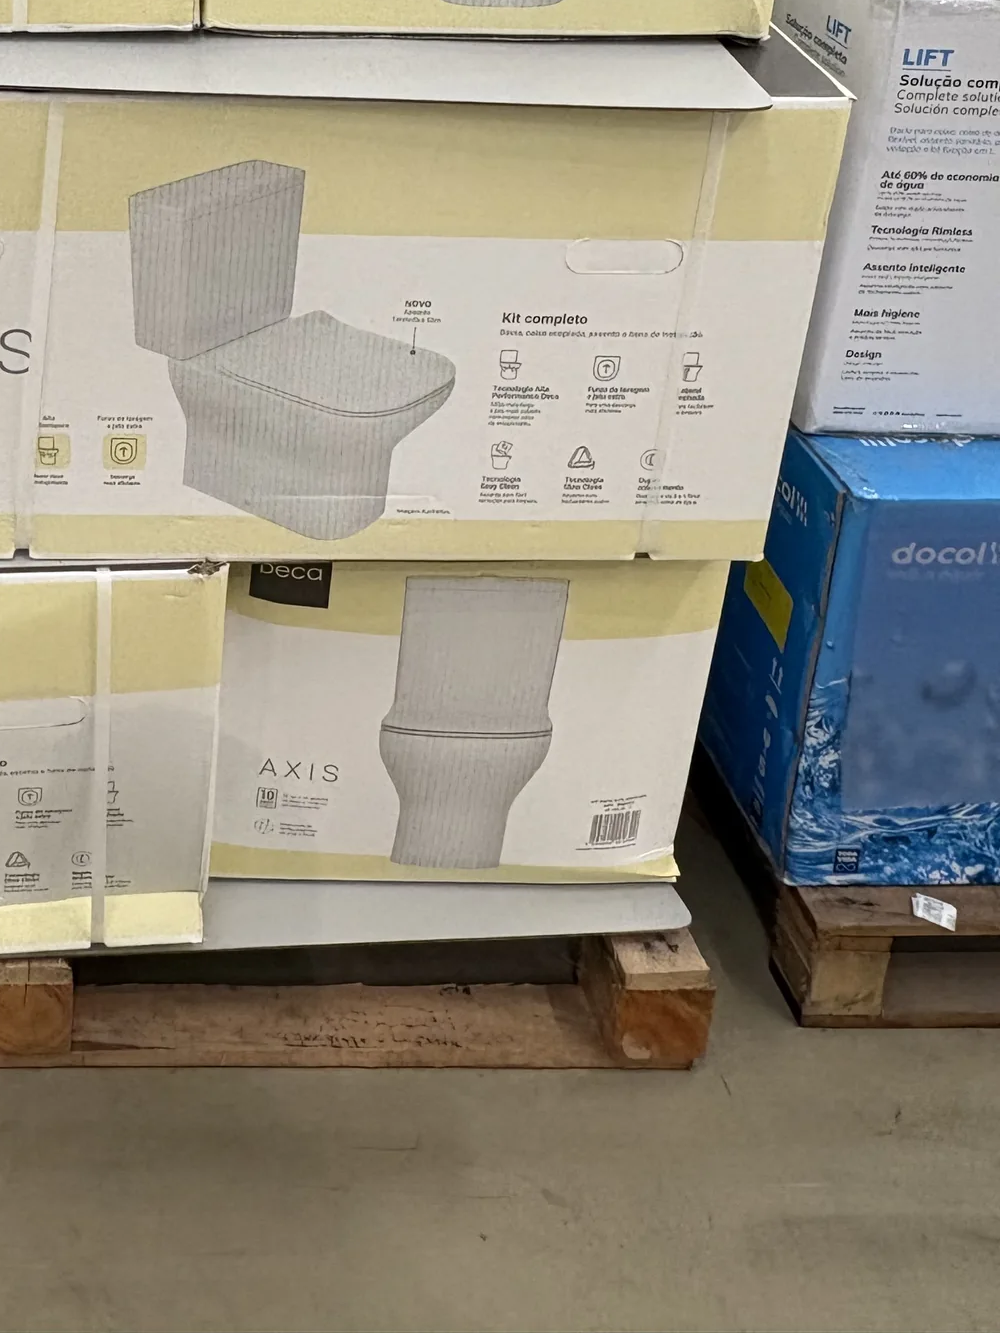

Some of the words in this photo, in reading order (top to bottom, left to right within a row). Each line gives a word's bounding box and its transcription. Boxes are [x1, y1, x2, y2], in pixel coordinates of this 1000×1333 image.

[826, 15, 852, 44] LIFT
[902, 48, 954, 67] LIFT
[899, 74, 962, 89] Solução
[967, 79, 1000, 92] com
[897, 89, 959, 103] Complete
[894, 102, 949, 115] Solución
[953, 106, 1000, 117] comple
[904, 171, 927, 180] 60%
[930, 172, 944, 180] de
[947, 173, 1000, 182] economia
[880, 180, 893, 189] de
[896, 180, 924, 191] água
[871, 225, 929, 237] Tecnologia
[863, 262, 907, 272] Assento
[909, 263, 966, 274] inteligente
[405, 300, 432, 308] NOVO
[502, 312, 521, 324] Kit
[524, 314, 588, 327] completo
[854, 309, 879, 318] Mais
[881, 309, 920, 319] higiene
[845, 350, 882, 360] Design
[891, 542, 986, 565] docol
[258, 758, 339, 782] AXIS
[261, 789, 275, 801] 10
